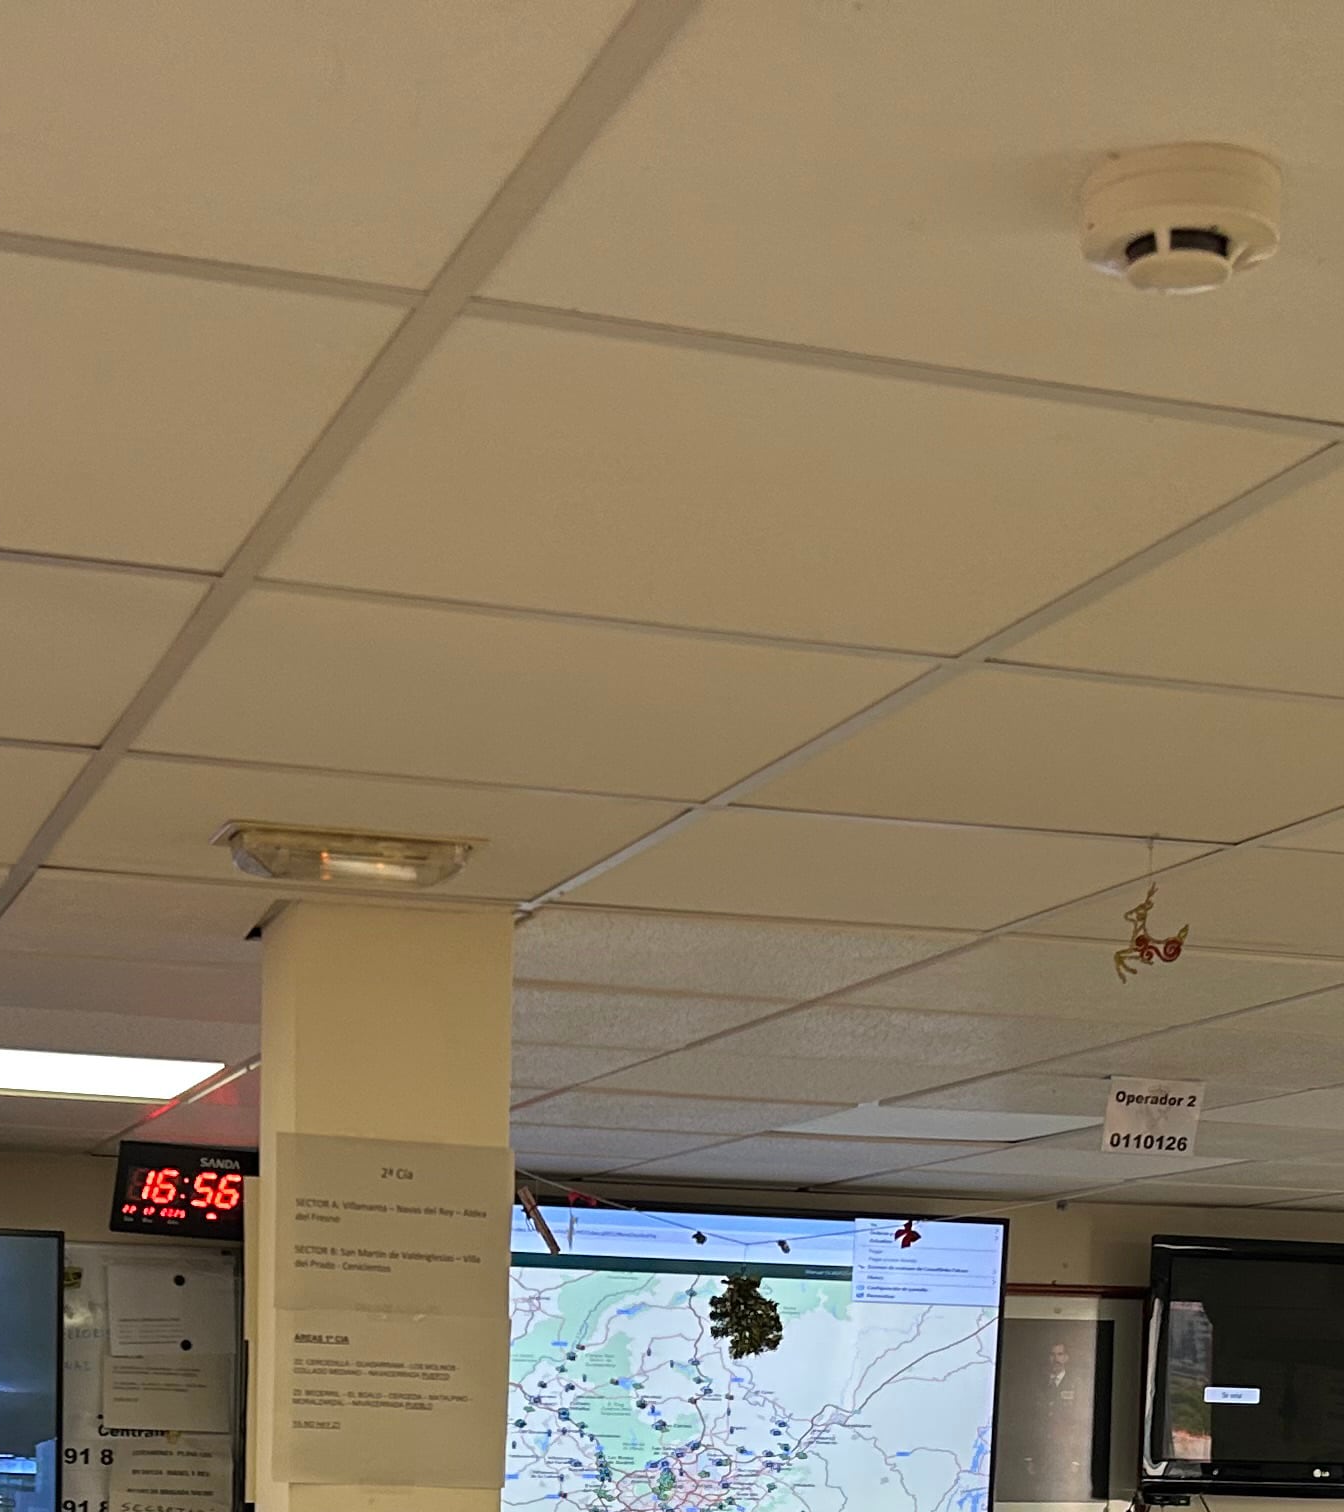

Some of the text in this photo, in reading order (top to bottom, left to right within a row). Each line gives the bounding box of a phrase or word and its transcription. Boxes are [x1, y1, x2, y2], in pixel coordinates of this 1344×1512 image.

[1116, 1090, 1197, 1107] Operador 2
[1109, 1132, 1189, 1152] 0110126
[199, 1156, 241, 1170] SANDA
[140, 1167, 243, 1210] 16:56
[64, 1448, 90, 1465] 91
